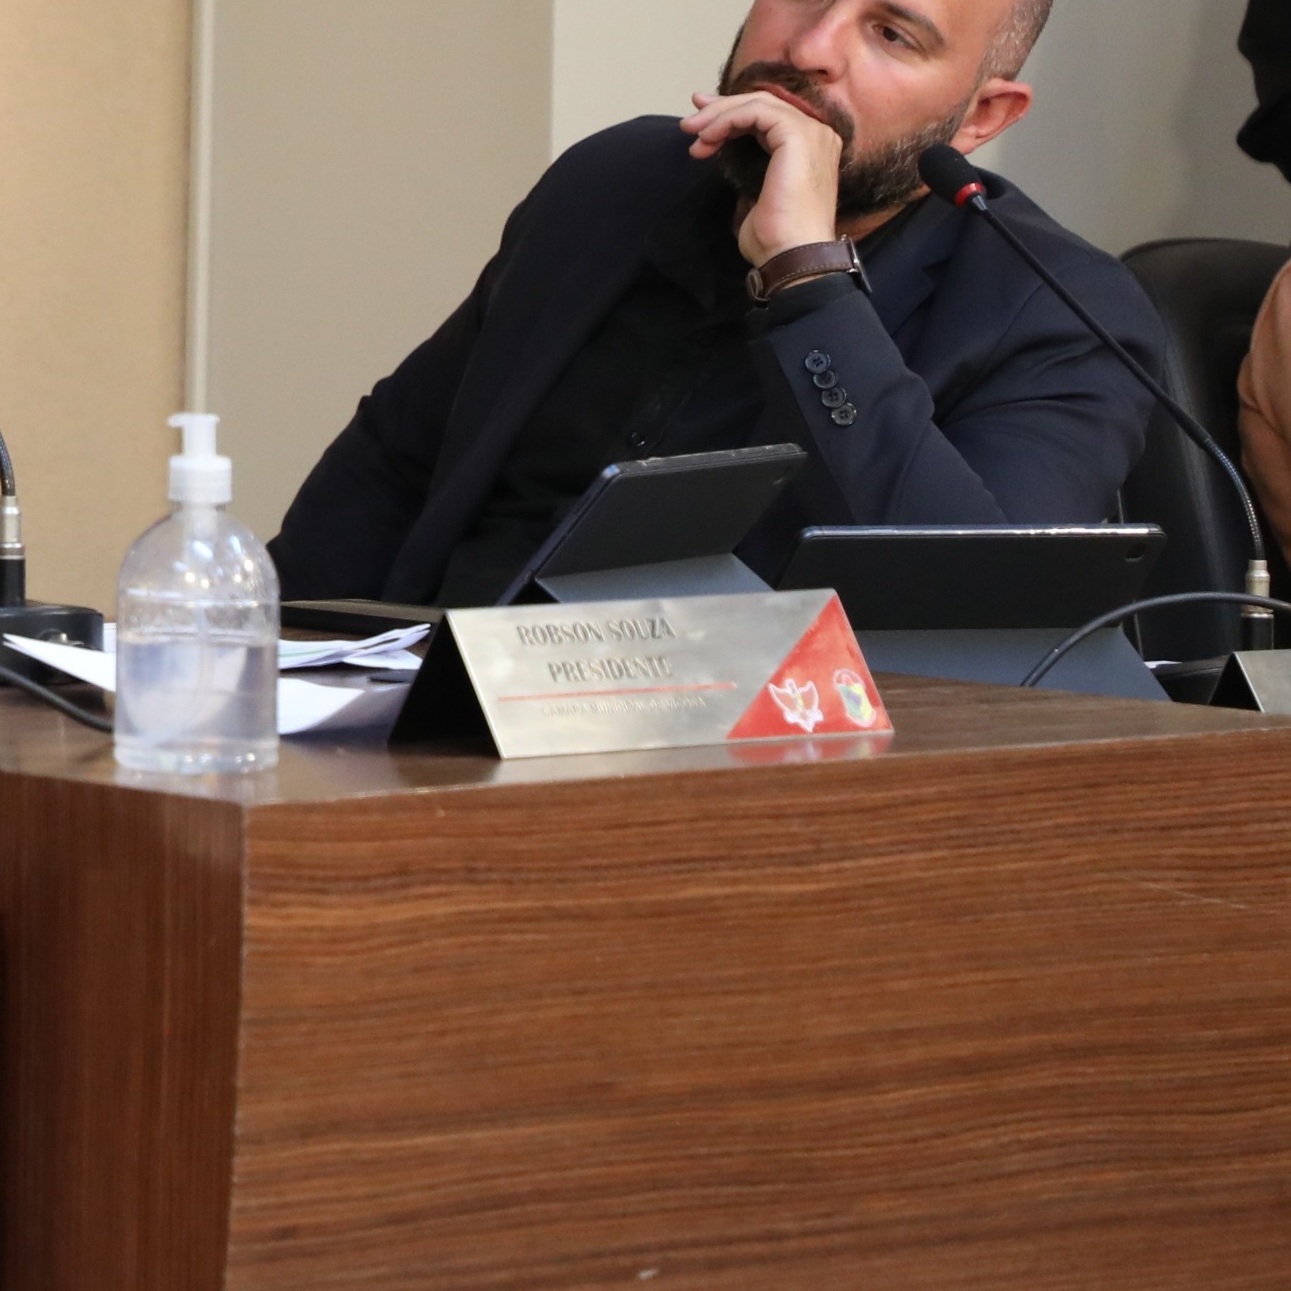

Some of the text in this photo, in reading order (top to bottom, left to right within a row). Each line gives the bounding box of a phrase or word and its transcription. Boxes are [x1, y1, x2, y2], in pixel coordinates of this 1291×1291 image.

[516, 617, 676, 646] ROBSON SOUZA
[547, 656, 673, 683] PRESIDENTE
